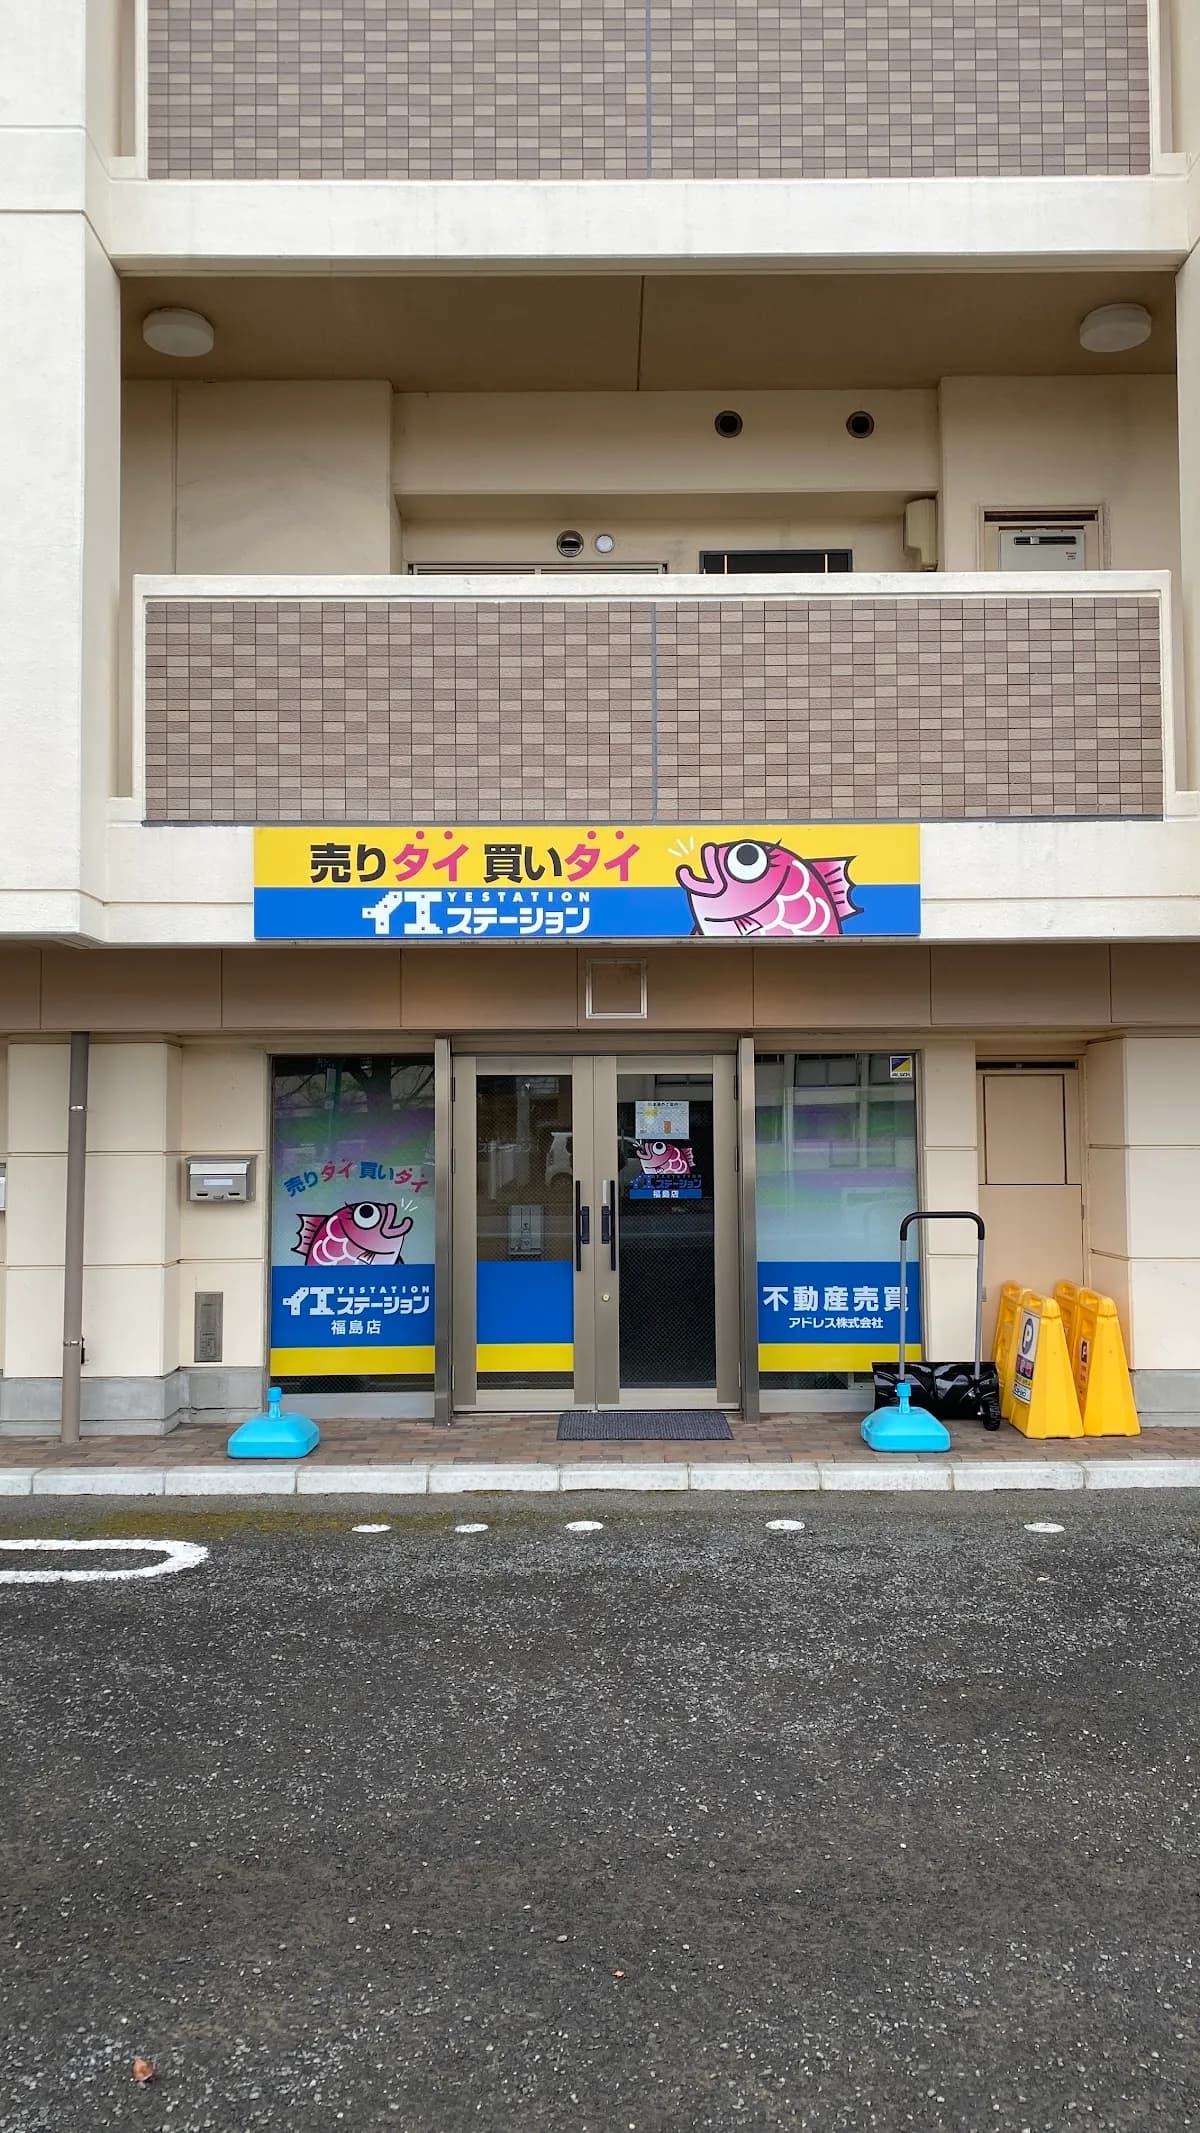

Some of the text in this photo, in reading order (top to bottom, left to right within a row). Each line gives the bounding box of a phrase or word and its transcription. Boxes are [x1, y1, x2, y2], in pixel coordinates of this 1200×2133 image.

[310, 842, 641, 884] 売りタイ 買いタイ
[447, 891, 590, 902] YESTATION
[283, 1160, 429, 1197] 売りタイ 買いタイ
[337, 1286, 430, 1294] YESTATION
[762, 1286, 909, 1312] 不動産売買
[331, 1319, 382, 1335] 福島店
[788, 1317, 884, 1329] アドレス株式会社
